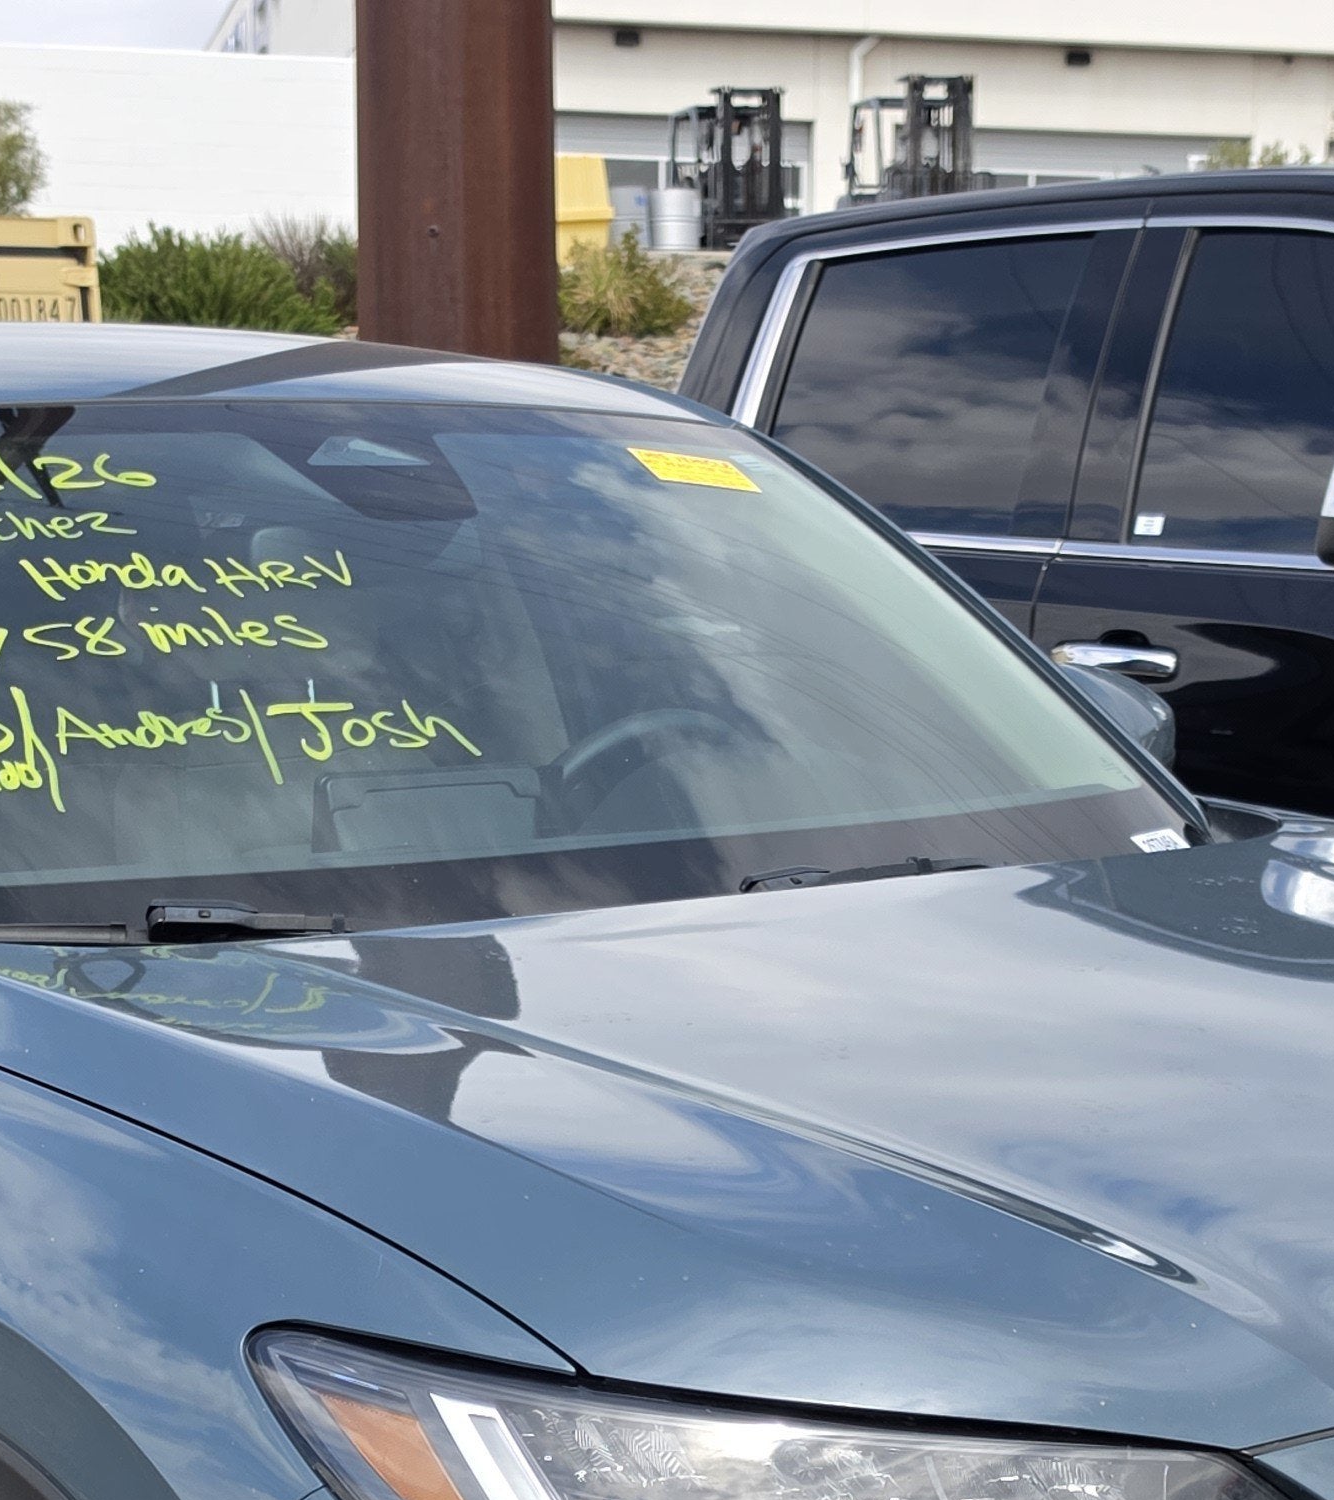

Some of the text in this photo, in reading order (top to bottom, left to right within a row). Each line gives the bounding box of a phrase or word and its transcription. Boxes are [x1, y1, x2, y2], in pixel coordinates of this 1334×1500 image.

[19, 552, 207, 601] Honda
[203, 550, 351, 598] HR-V
[138, 605, 329, 653] miles
